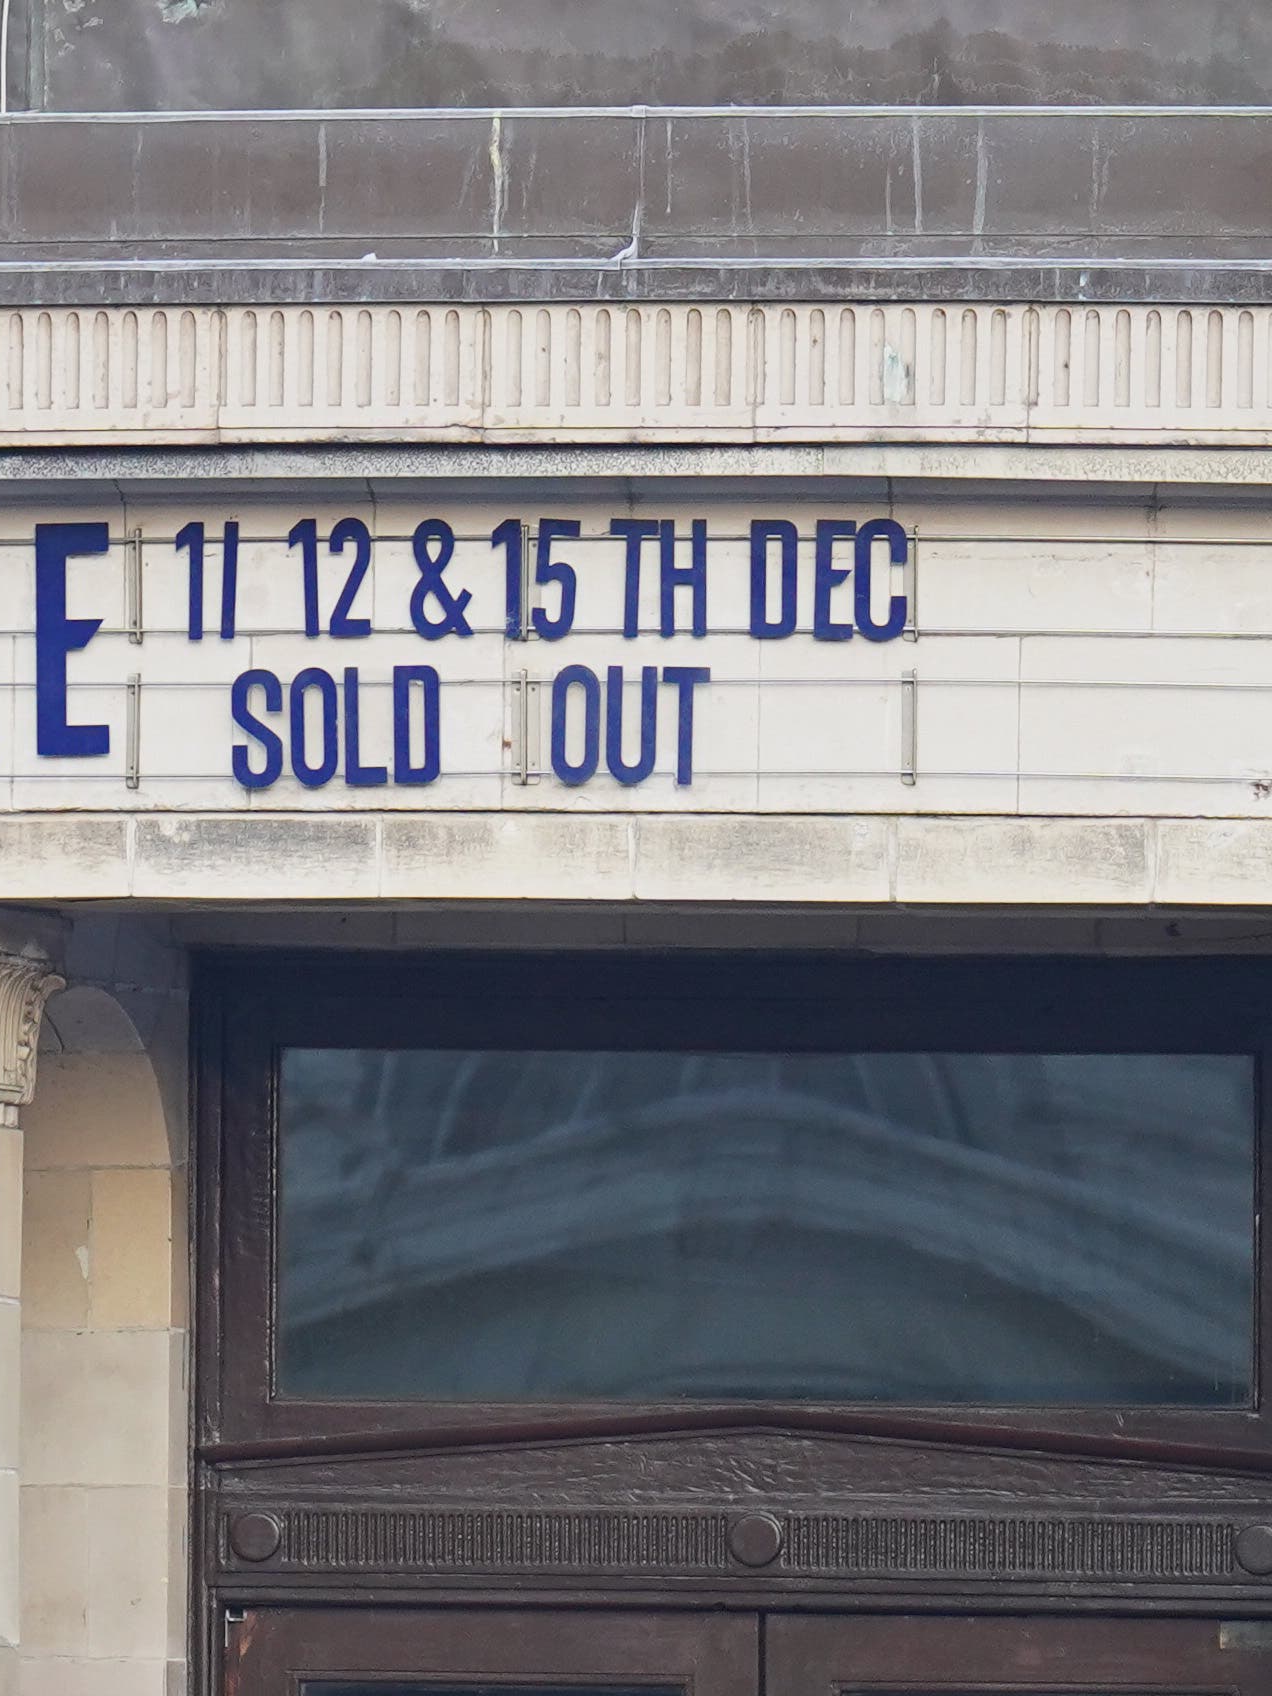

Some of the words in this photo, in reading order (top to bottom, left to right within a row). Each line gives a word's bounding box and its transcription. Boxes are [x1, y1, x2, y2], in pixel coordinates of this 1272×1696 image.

[288, 517, 372, 637] 12
[410, 518, 474, 640] &
[750, 519, 908, 642] DEC
[231, 665, 440, 788] SOLD
[551, 664, 711, 786] OUT
